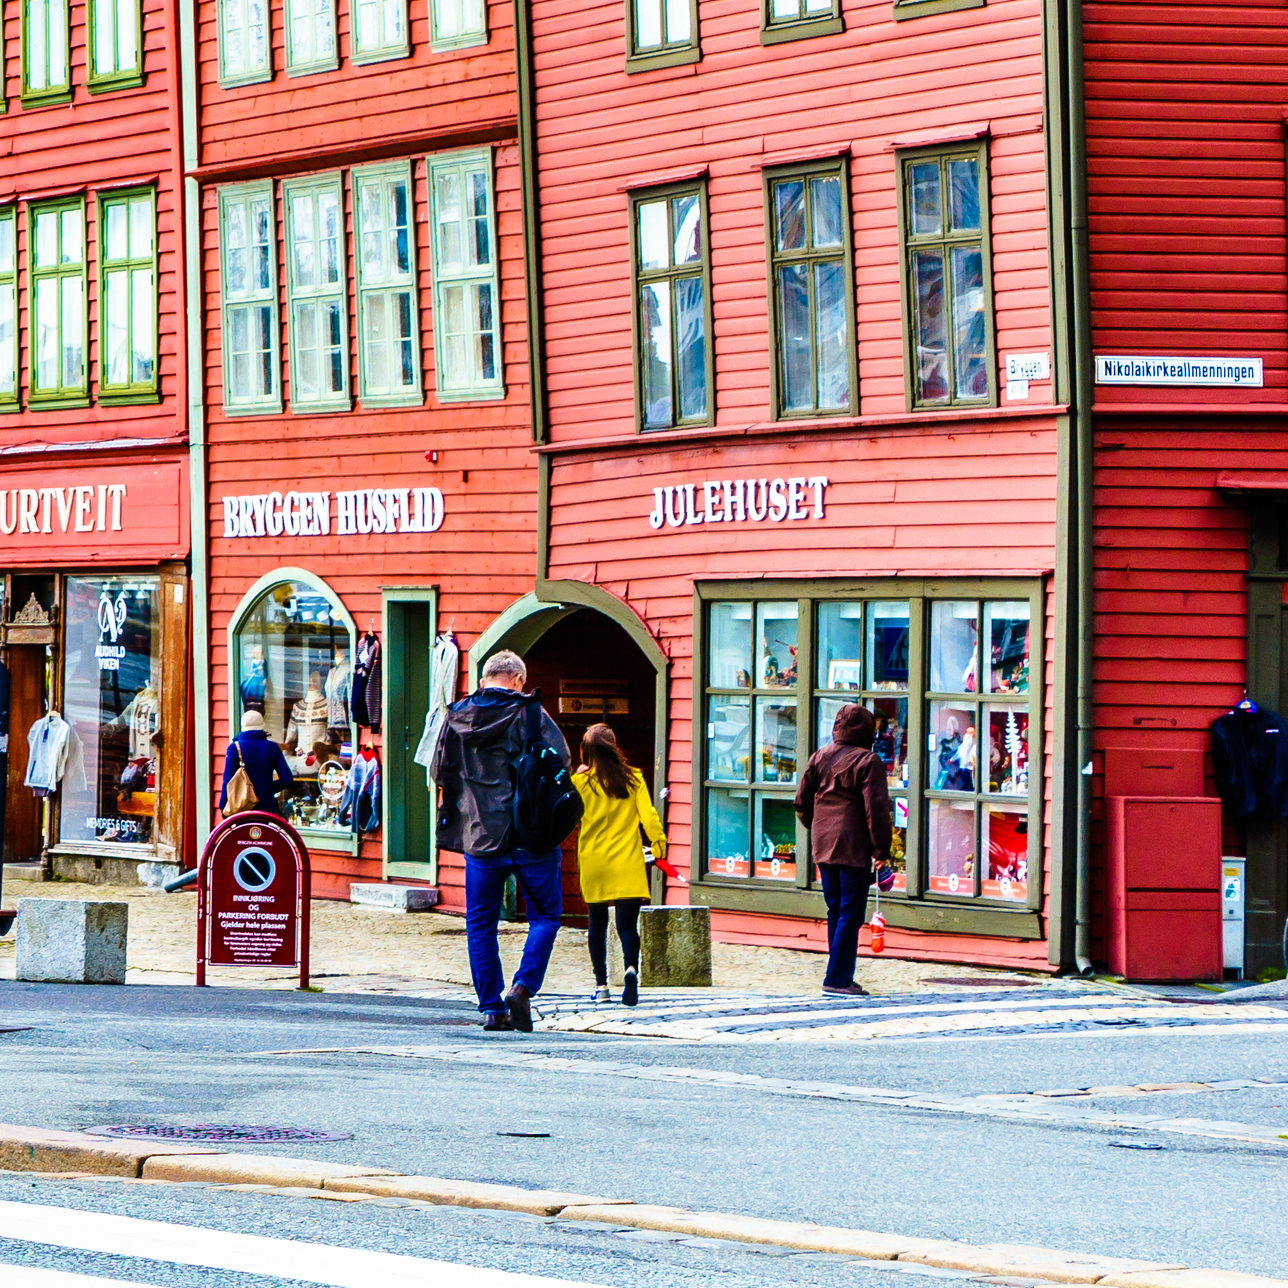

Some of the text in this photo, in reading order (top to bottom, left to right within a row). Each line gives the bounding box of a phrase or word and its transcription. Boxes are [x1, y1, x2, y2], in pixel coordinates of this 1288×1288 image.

[1010, 359, 1042, 378] Bryggen
[1104, 360, 1255, 382] Nikolaikirkeallmenningen
[649, 476, 829, 530] JULEHUSET
[222, 487, 445, 538] BRYGGEN HUSFLID
[95, 644, 125, 659] AUDHILD
[98, 658, 120, 671] VIKEN
[86, 817, 115, 830] MEMORIES
[121, 820, 138, 832] GIFTS
[233, 895, 275, 903] INNKJØRING
[218, 912, 289, 921] PARKERING FORBUDT
[220, 921, 286, 930] Gjelder hele plassen
